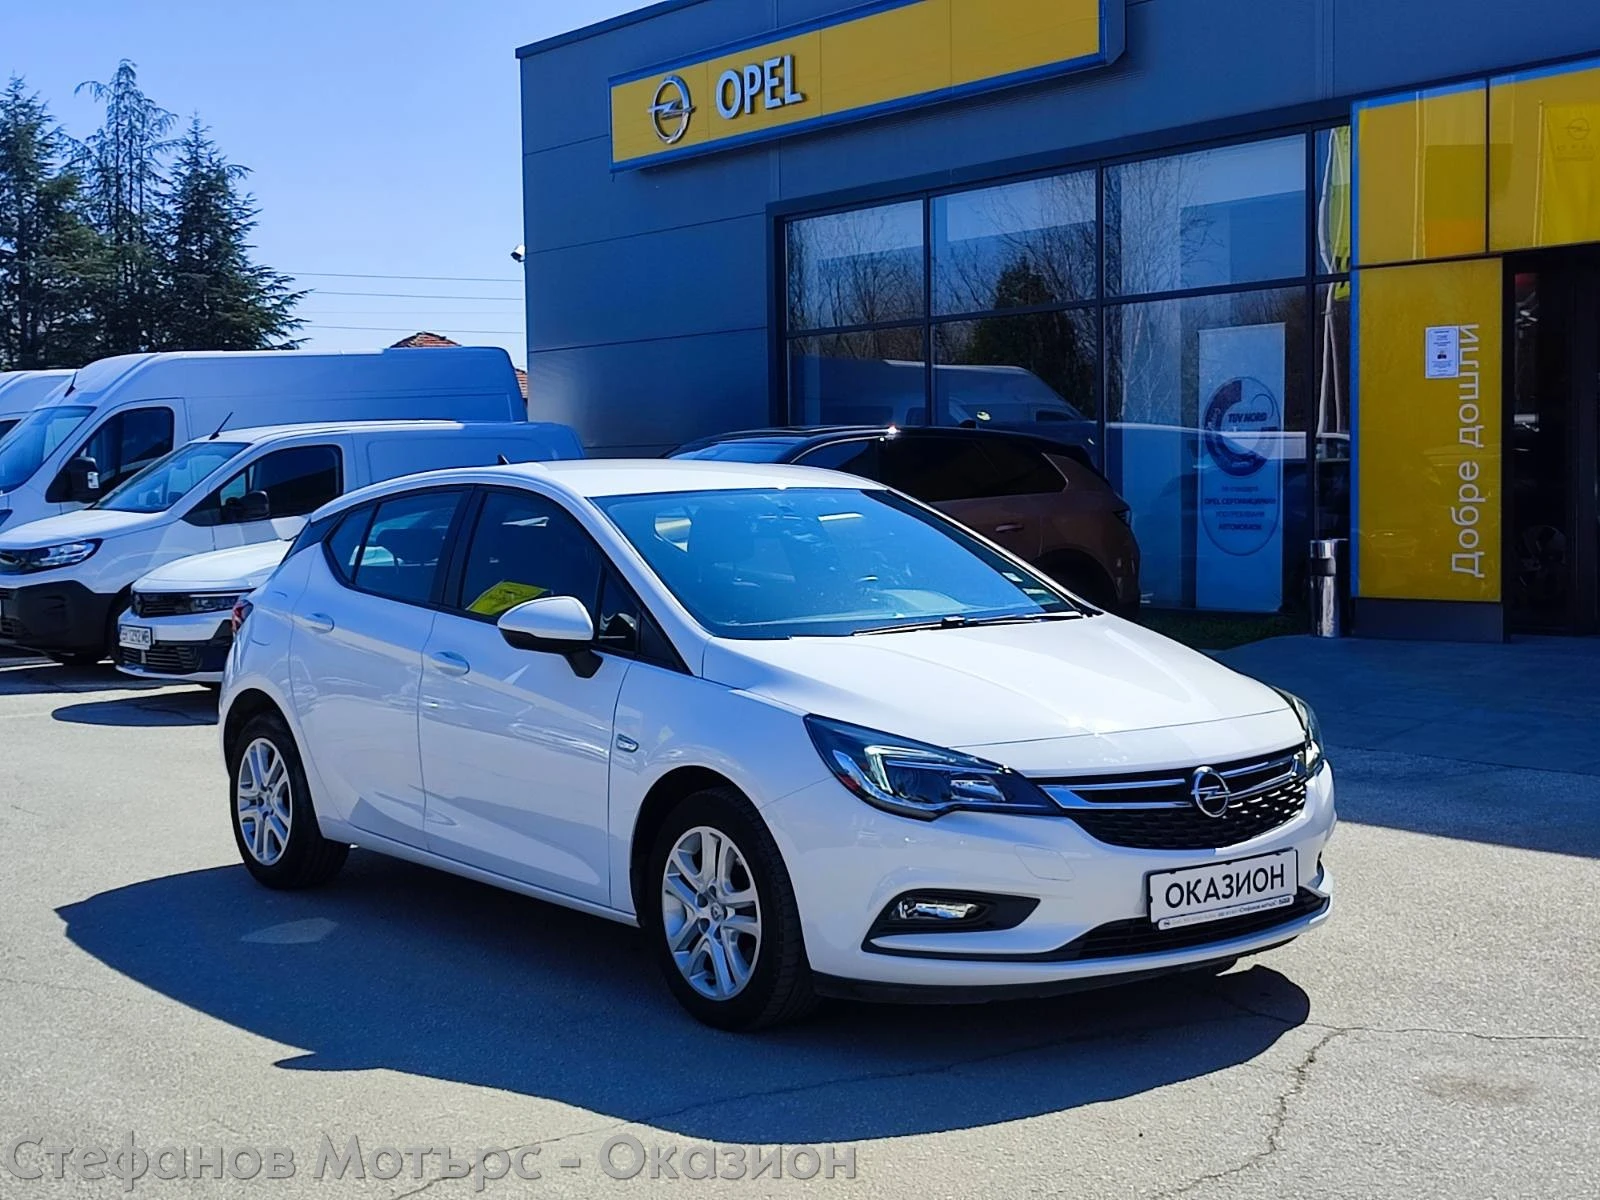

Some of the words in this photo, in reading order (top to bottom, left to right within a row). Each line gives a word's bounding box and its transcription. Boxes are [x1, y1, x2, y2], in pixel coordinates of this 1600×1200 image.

[715, 54, 804, 119] OPEL
[1457, 323, 1485, 449] дошли
[1451, 460, 1486, 578] Добре
[1165, 863, 1285, 908] ОКАЗИОН
